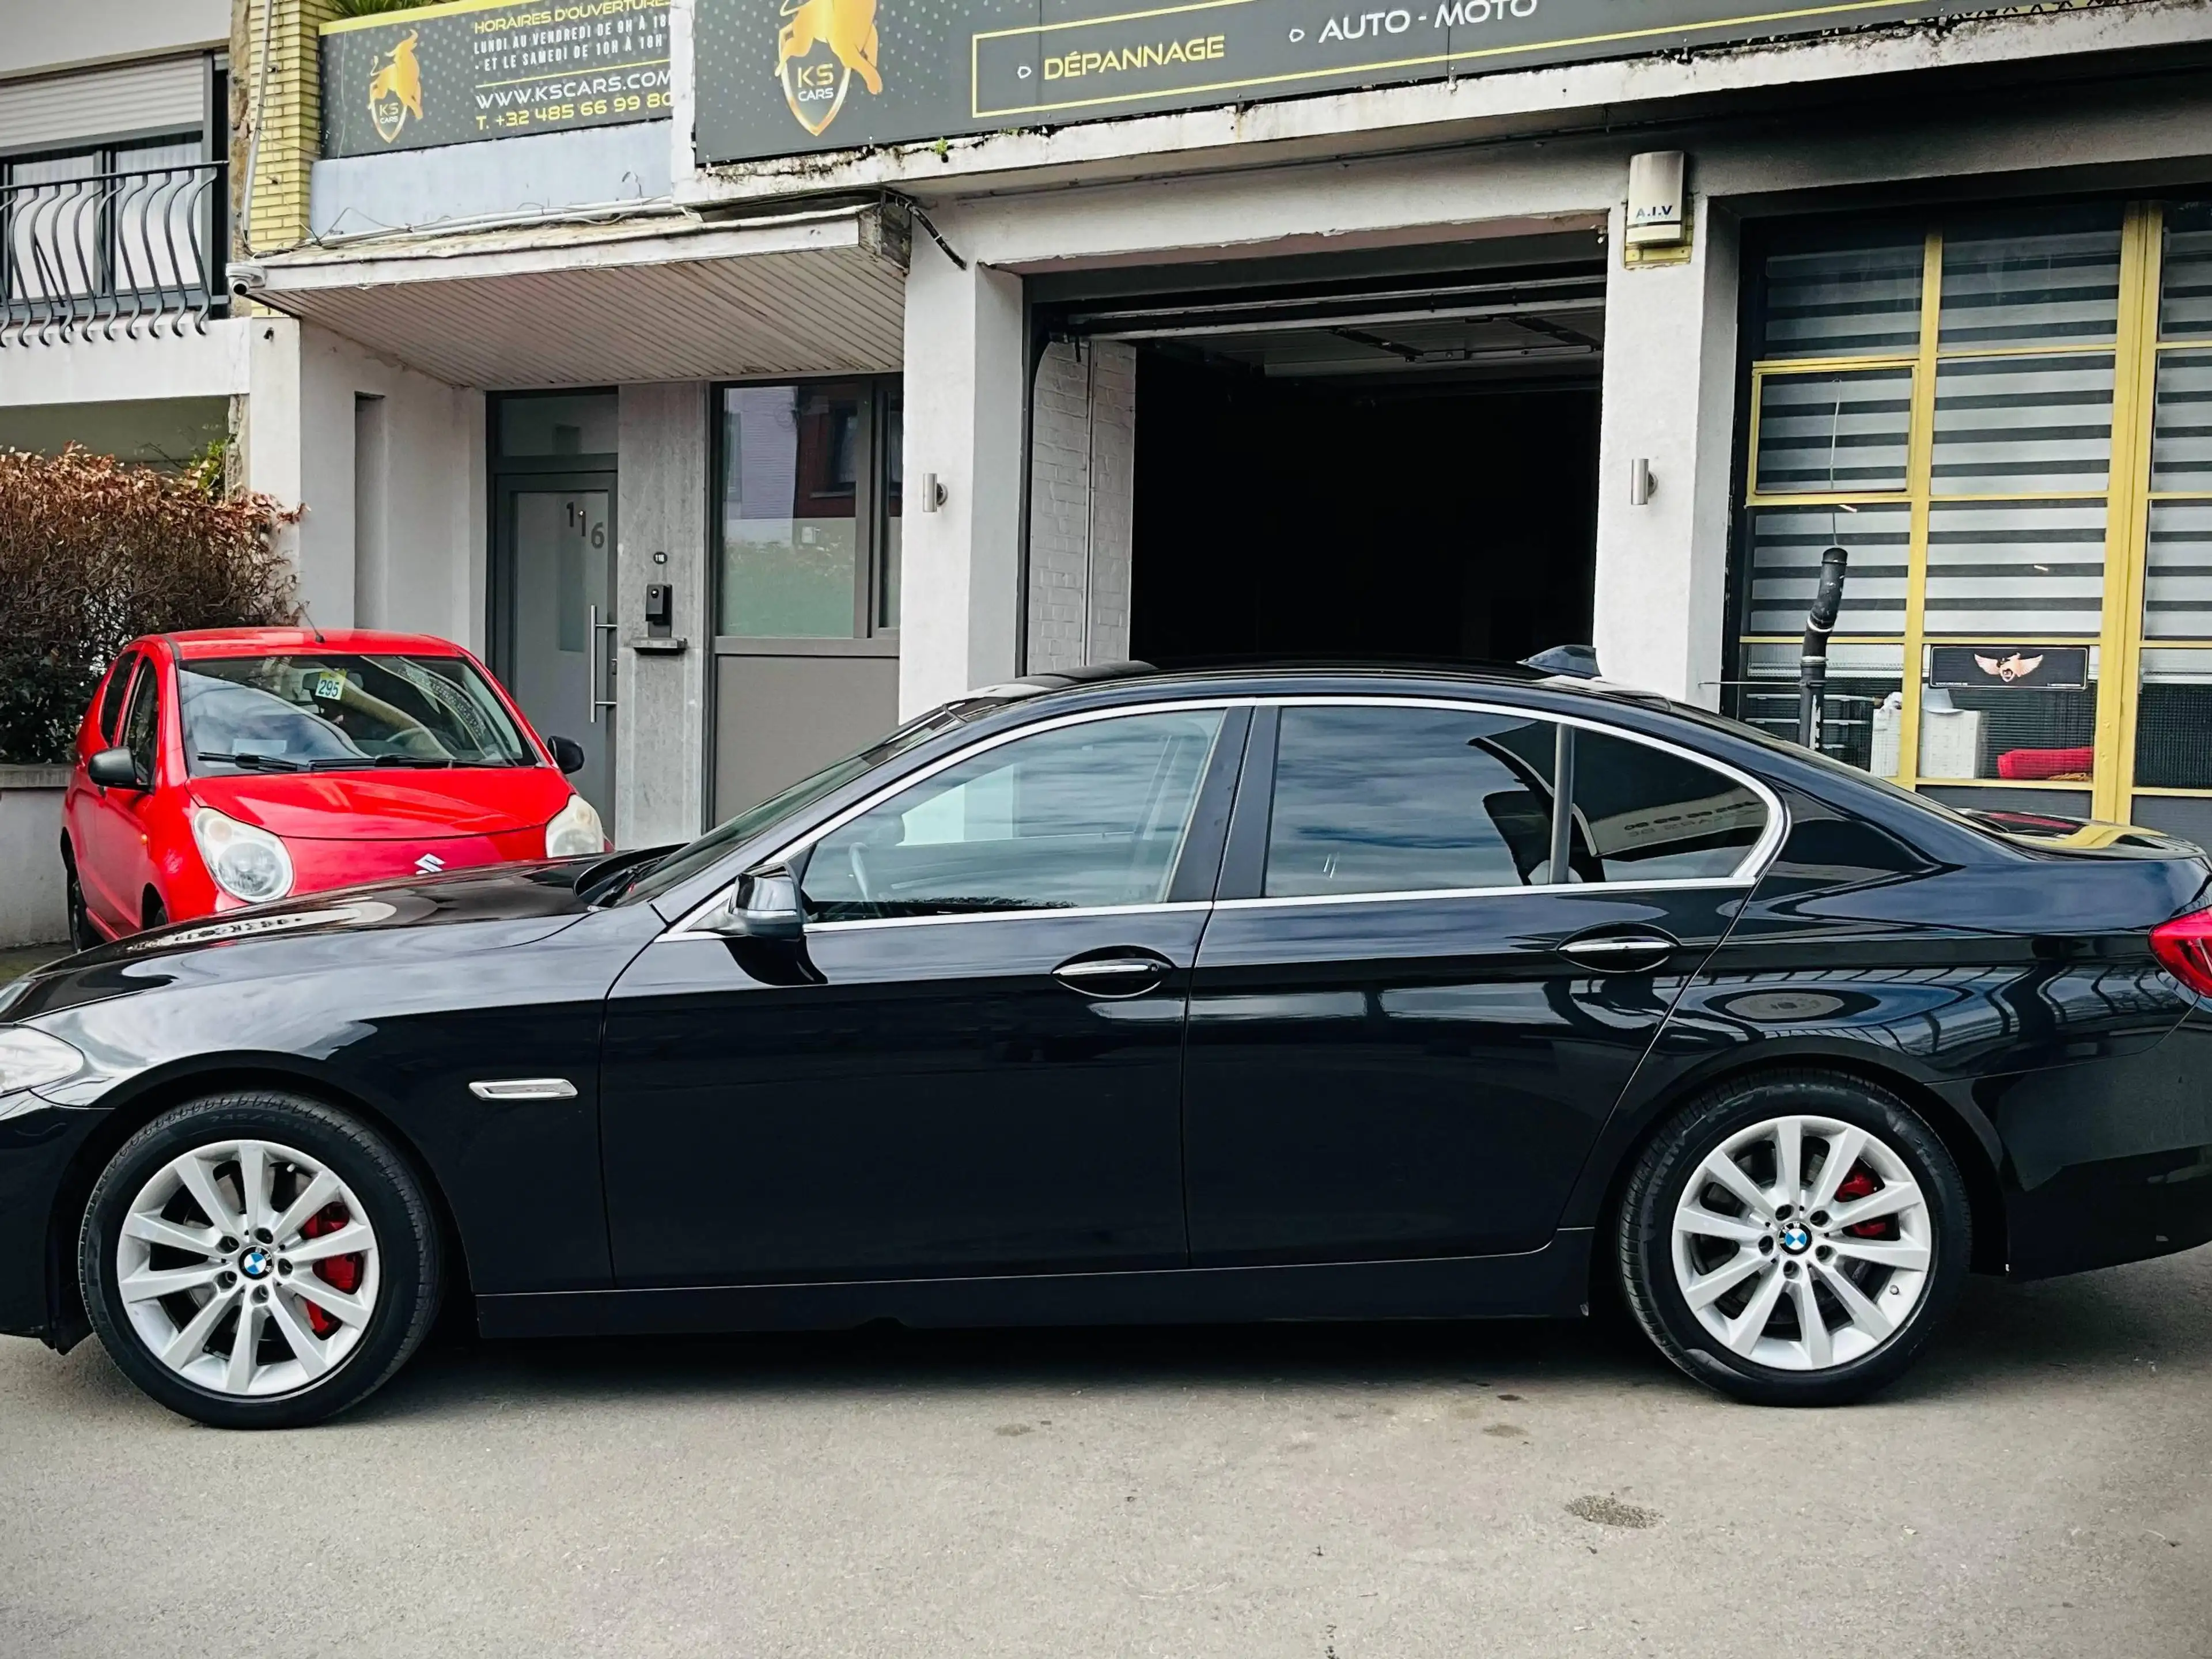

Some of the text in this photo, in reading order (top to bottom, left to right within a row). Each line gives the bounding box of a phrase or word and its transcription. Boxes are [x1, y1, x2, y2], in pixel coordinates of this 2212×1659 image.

[474, 11, 551, 34] HORAIRES
[1318, 9, 1410, 43] AUTO
[1434, 0, 1537, 28] MOTO
[474, 38, 507, 54] LUNDI
[513, 35, 527, 48] AU
[532, 25, 591, 46] VENDREDI
[597, 22, 611, 36] DE
[484, 58, 497, 71] ET
[503, 55, 516, 69] LE
[522, 47, 567, 66] SAMEDI
[573, 44, 588, 59] DE
[596, 40, 618, 55] 10H
[1044, 35, 1225, 80] DÉPANNAGE
[798, 63, 834, 88] KS
[798, 87, 834, 101] CARS
[380, 102, 399, 116] KS
[380, 116, 399, 124] CARS
[475, 115, 489, 130] T.
[495, 109, 529, 127] +32
[535, 104, 574, 121] 485
[581, 100, 607, 116] 66
[613, 95, 641, 112] 99
[566, 502, 605, 549] 116
[319, 680, 339, 697] 295
